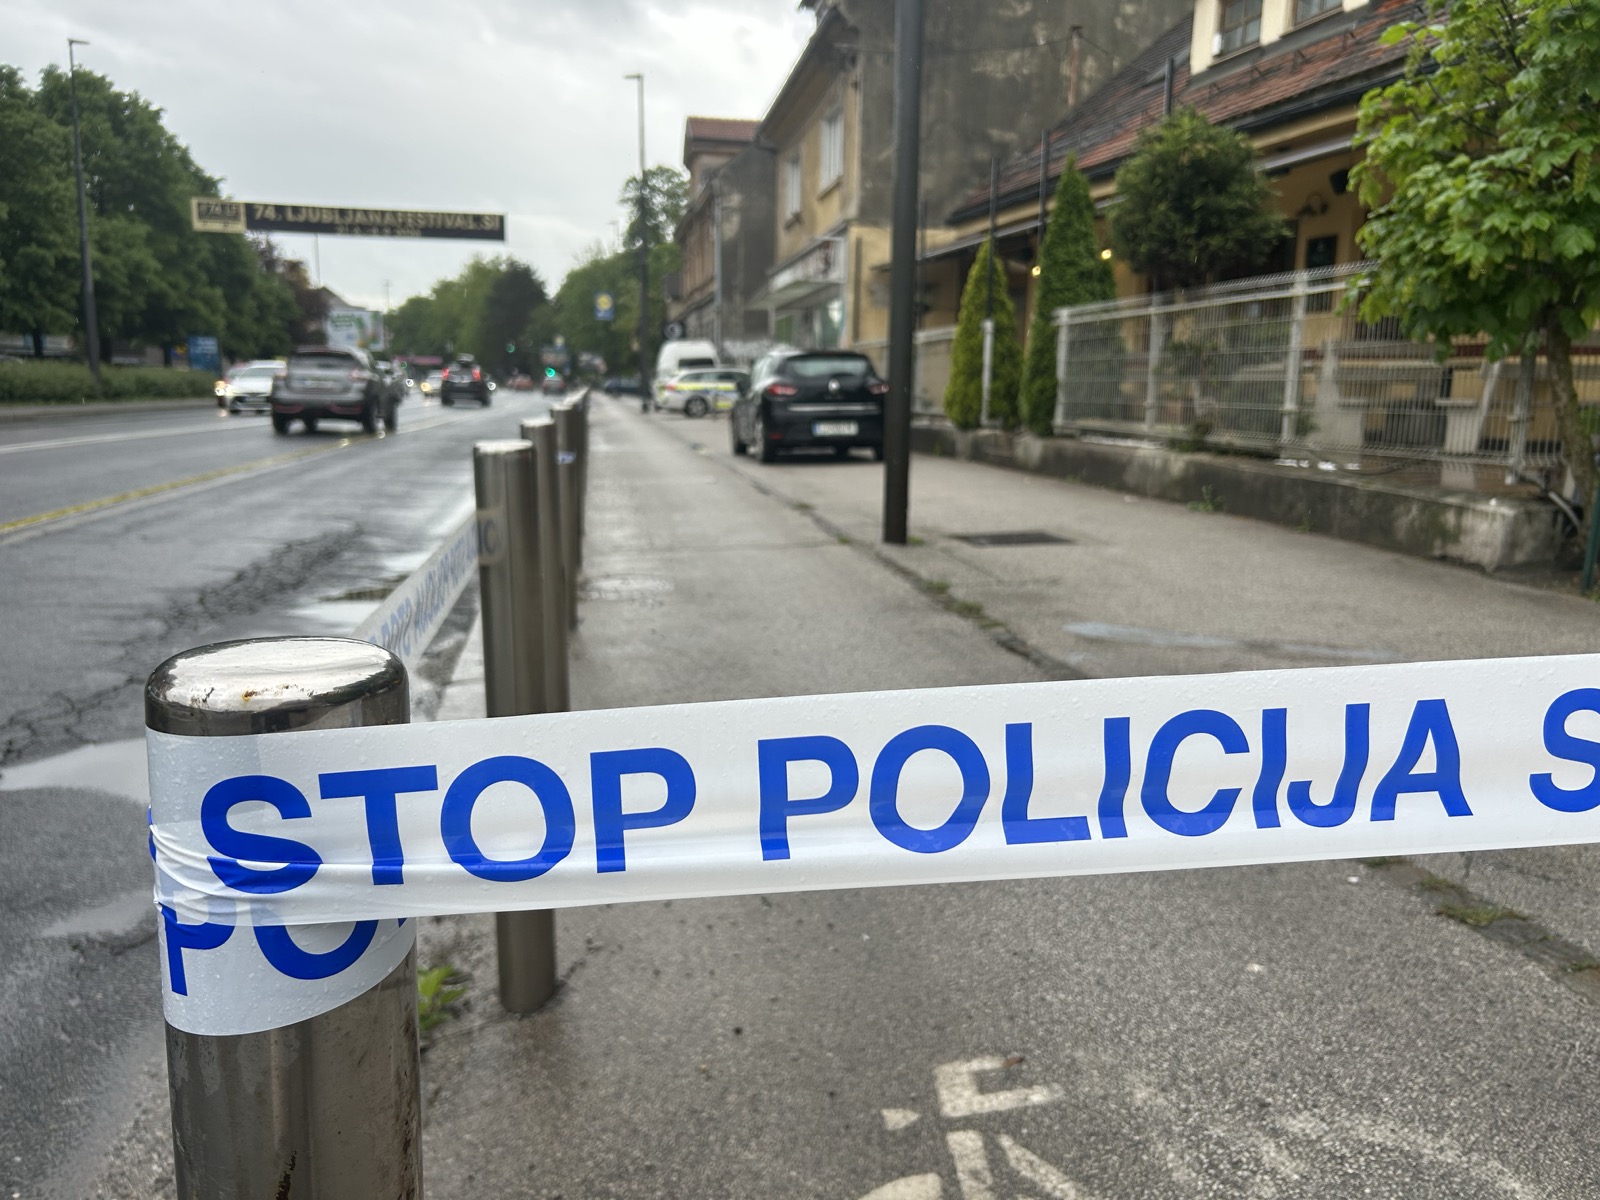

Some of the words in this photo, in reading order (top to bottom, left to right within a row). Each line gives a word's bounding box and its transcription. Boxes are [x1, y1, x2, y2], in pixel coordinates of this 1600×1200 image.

[201, 748, 696, 894] STOP
[758, 699, 1473, 860] POLICIJA
[160, 903, 406, 996] PO
